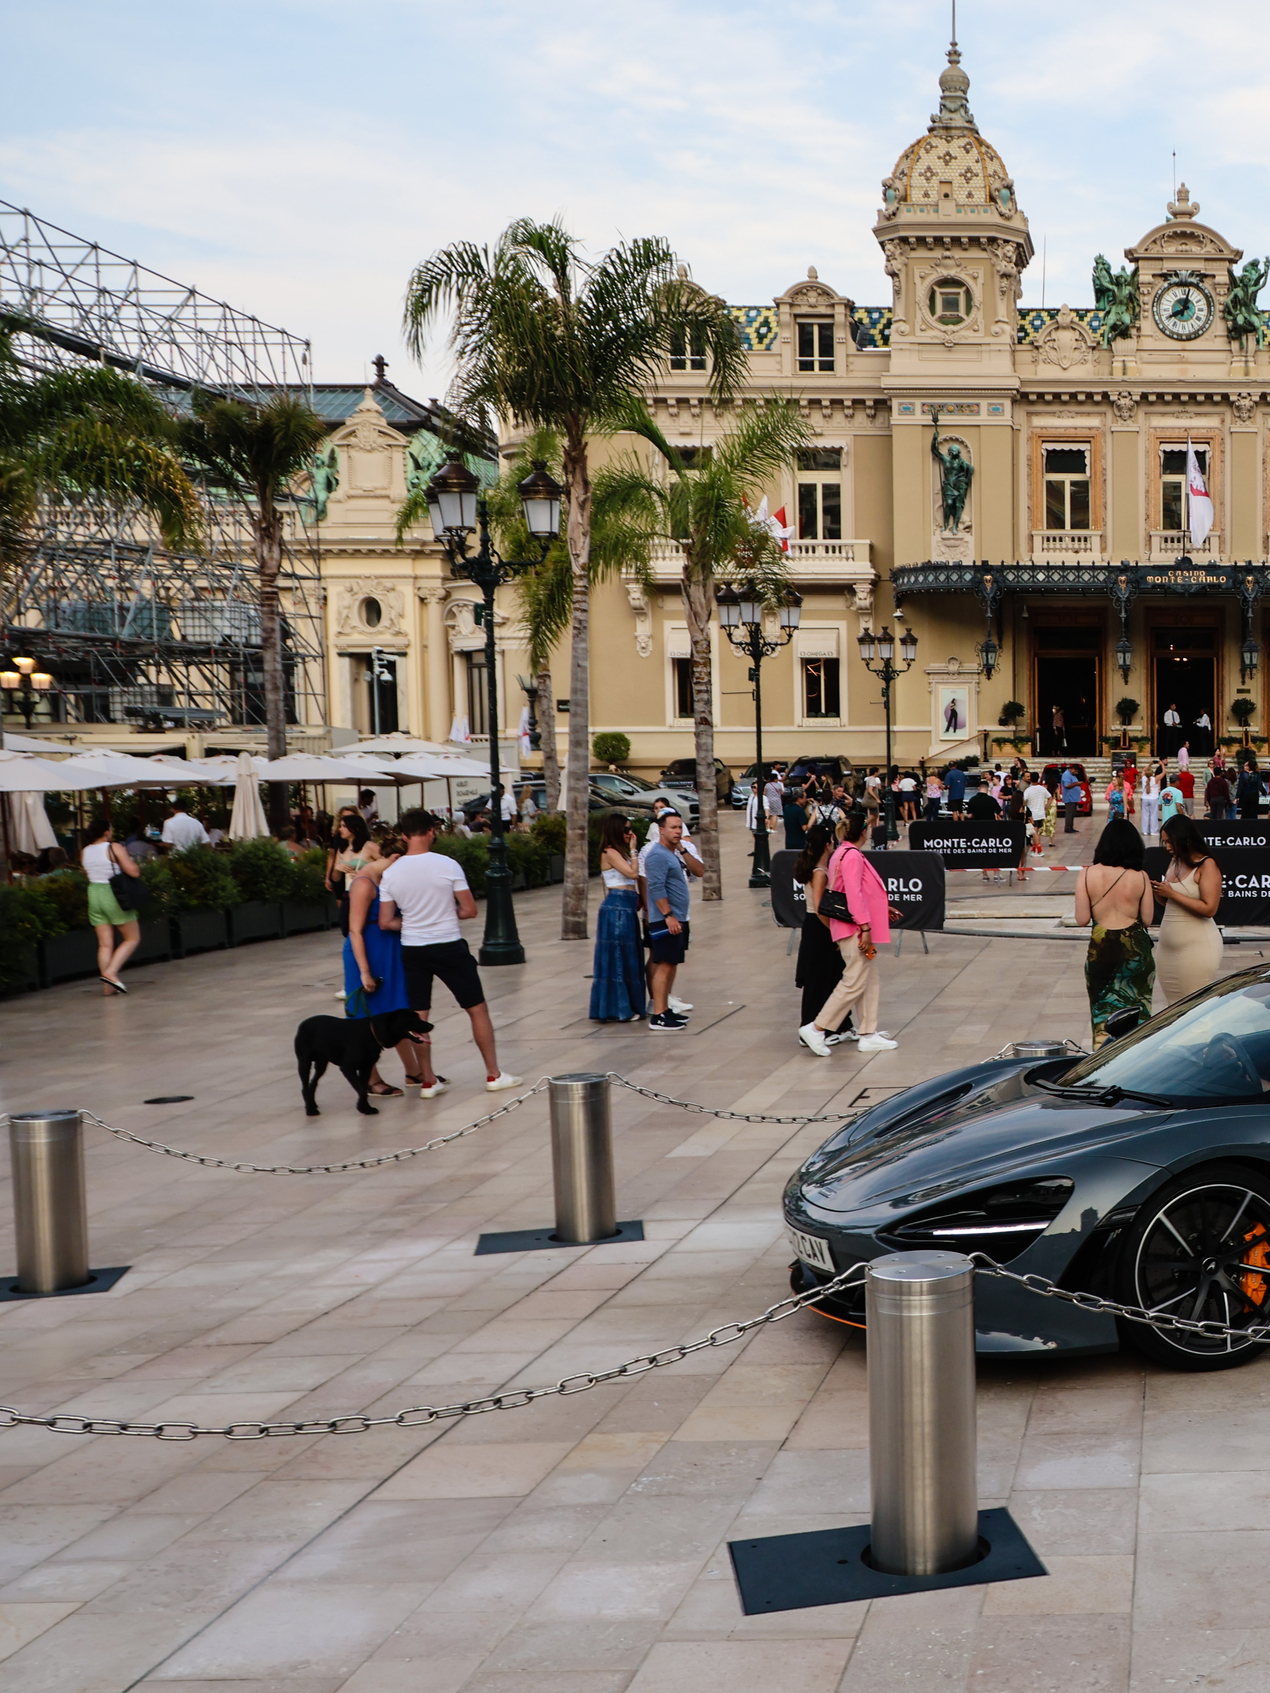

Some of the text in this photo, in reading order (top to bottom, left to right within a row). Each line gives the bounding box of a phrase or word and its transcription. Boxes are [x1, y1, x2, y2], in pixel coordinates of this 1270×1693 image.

[888, 893, 923, 901] DE MER
[1228, 890, 1258, 898] BAINS
